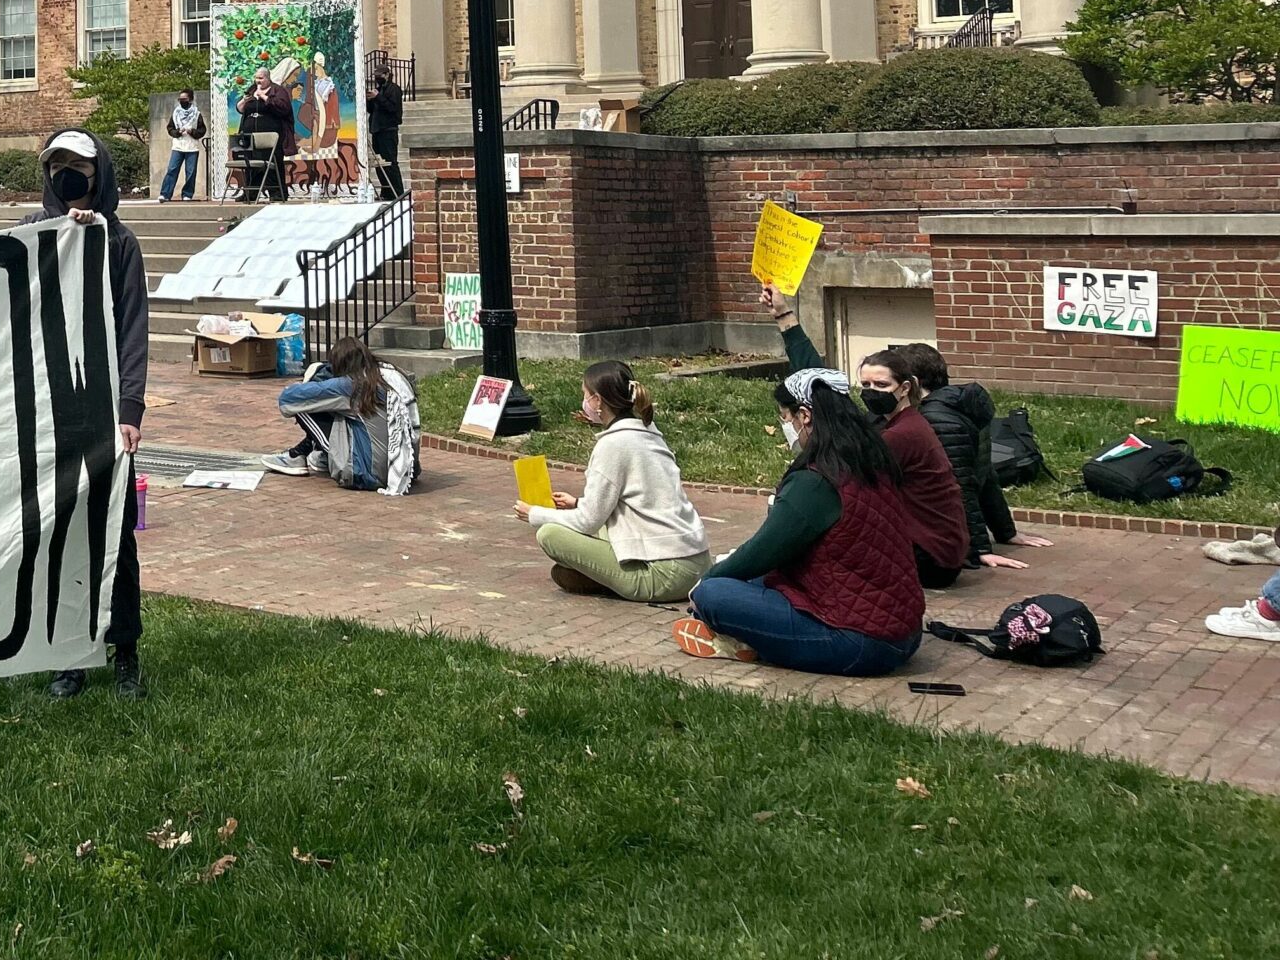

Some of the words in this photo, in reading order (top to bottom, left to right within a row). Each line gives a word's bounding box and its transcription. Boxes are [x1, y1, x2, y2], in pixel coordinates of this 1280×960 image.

[446, 275, 480, 295] HAND
[1057, 272, 1150, 305] FREE
[452, 300, 478, 320] OFF
[1056, 301, 1152, 332] GAZA
[1219, 378, 1280, 417] NO
